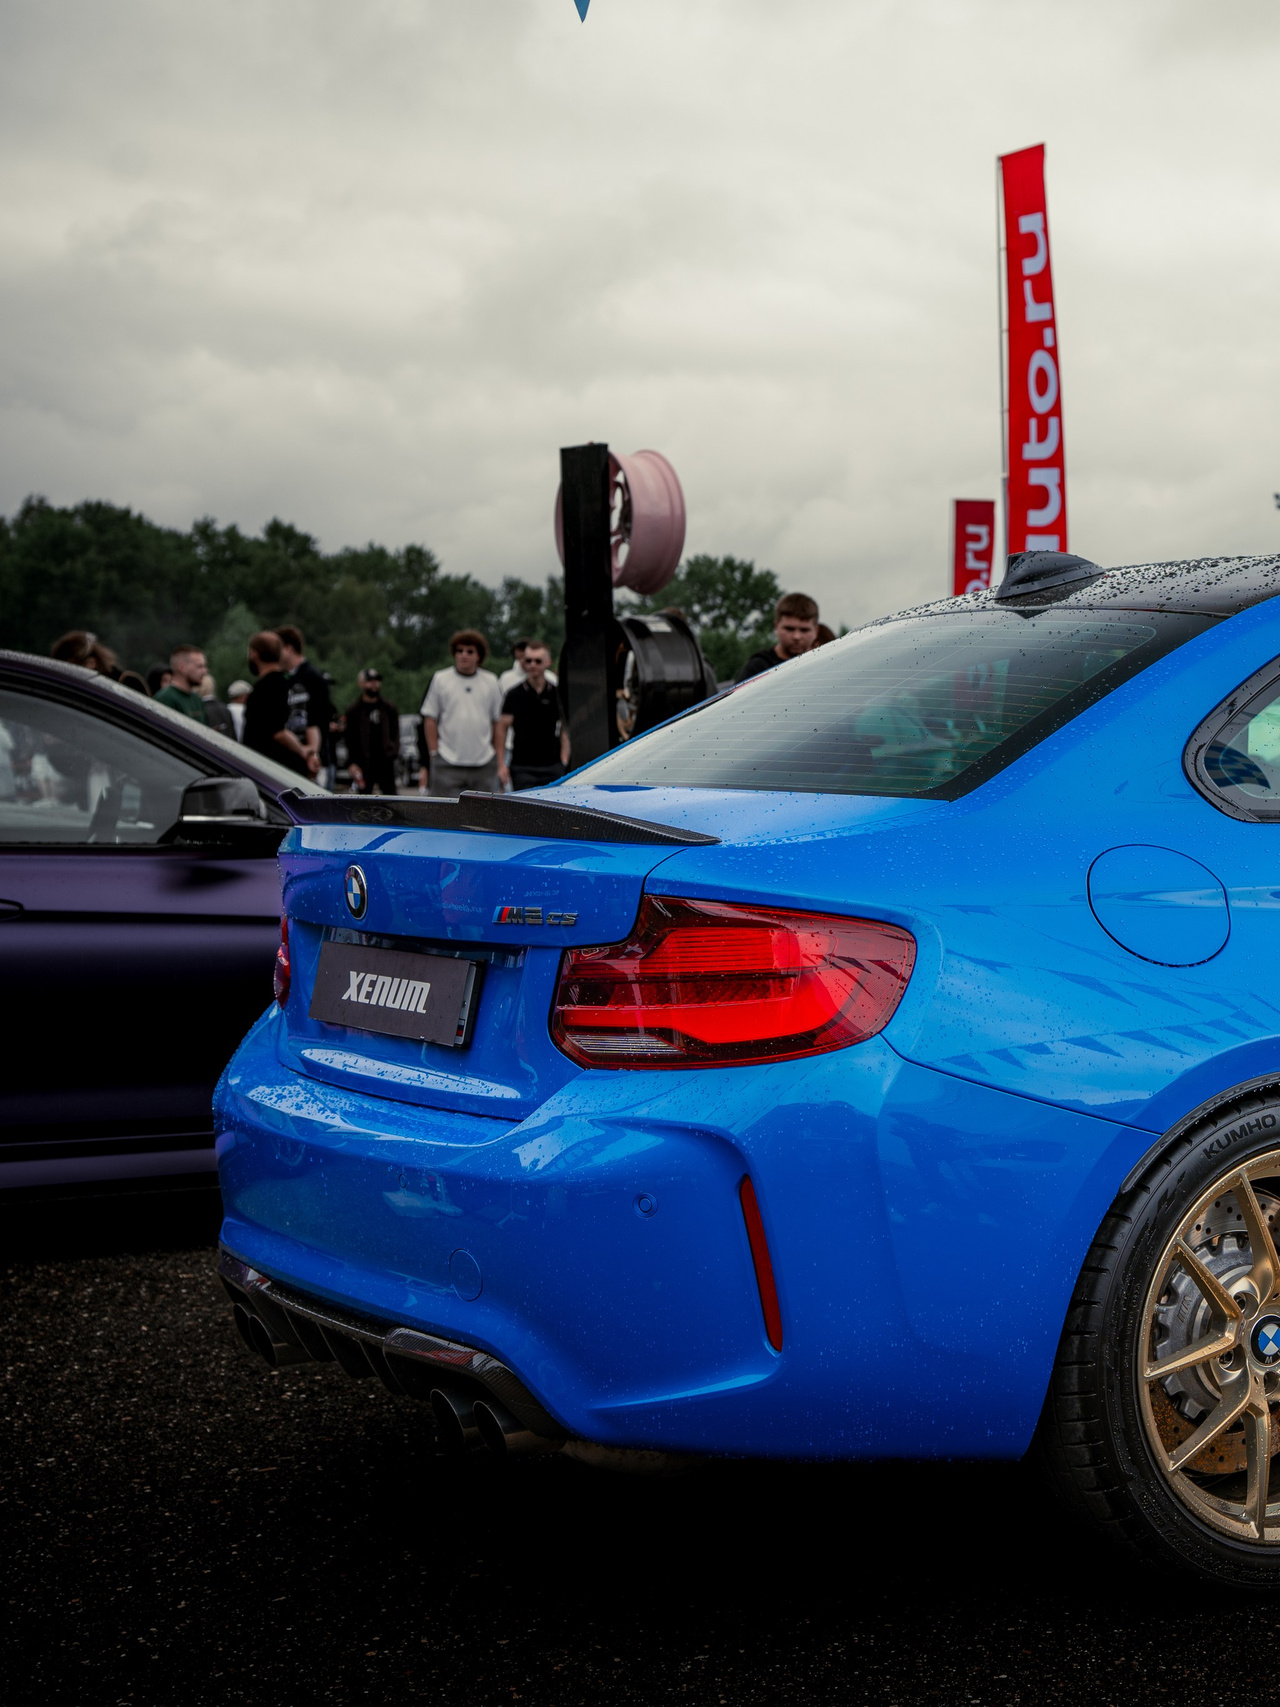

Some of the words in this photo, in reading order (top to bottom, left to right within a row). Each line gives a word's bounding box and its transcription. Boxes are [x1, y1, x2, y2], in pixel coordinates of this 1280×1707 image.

[1018, 211, 1062, 551] uto.ru
[546, 912, 578, 925] CS
[342, 971, 430, 1014] XENUM
[1203, 1113, 1276, 1160] KUMHO
